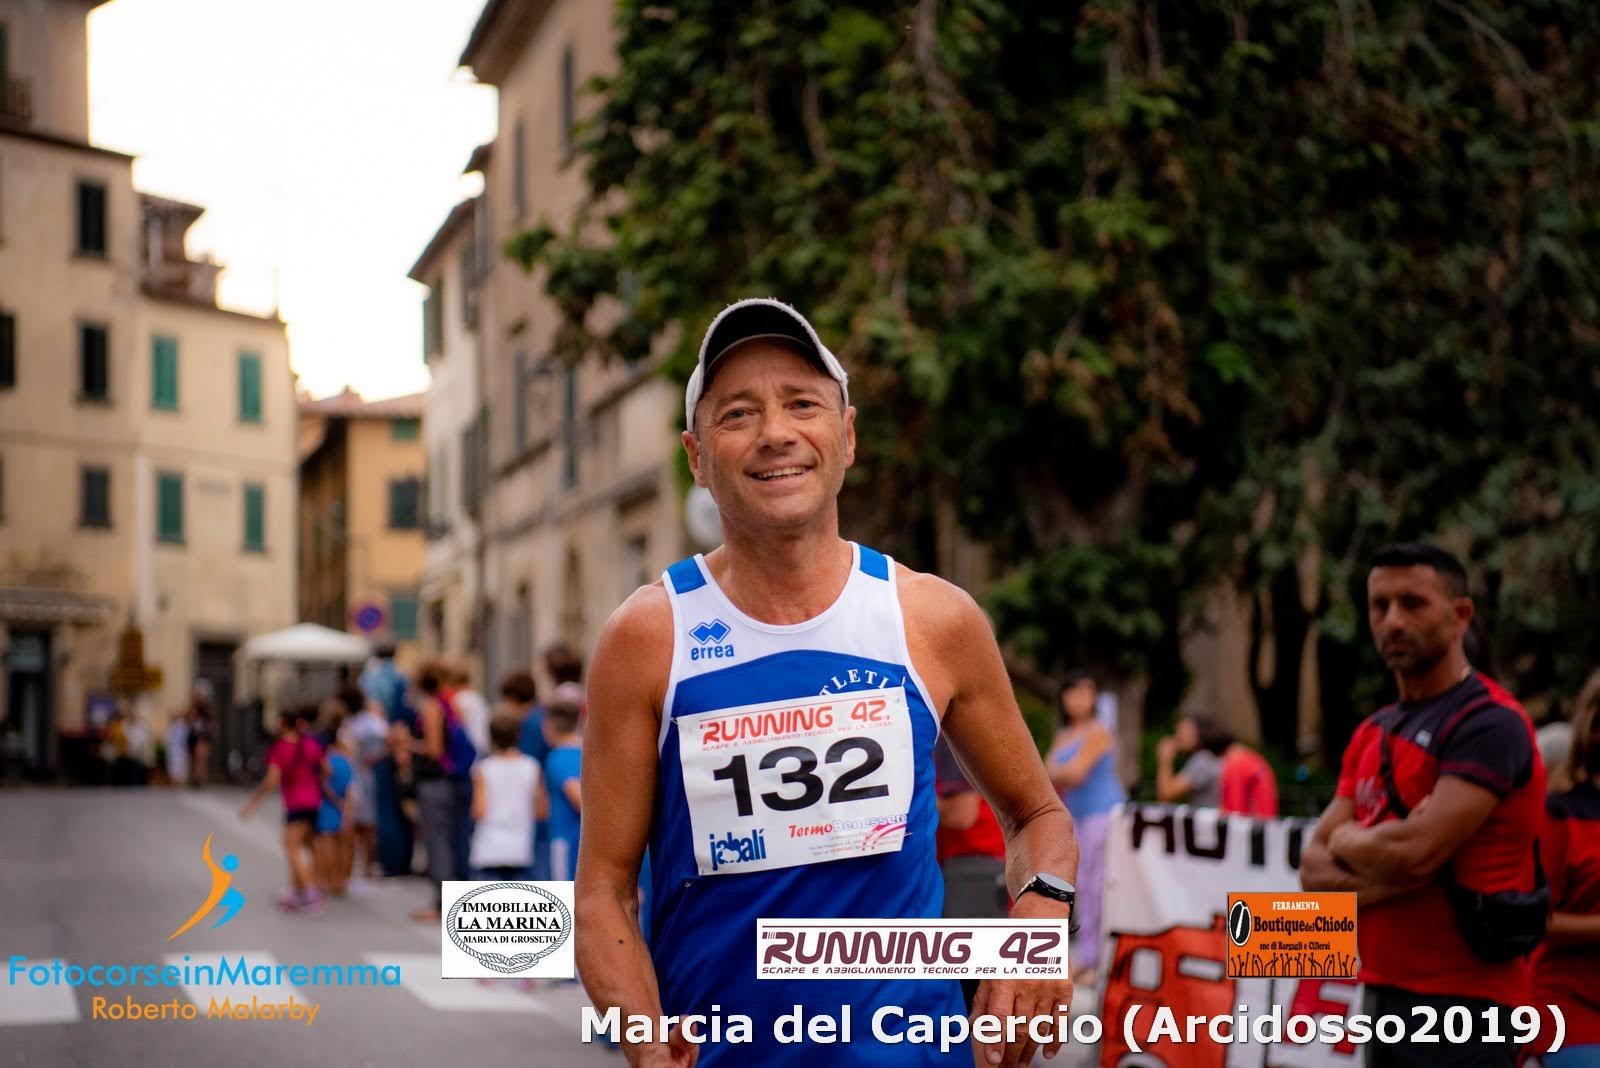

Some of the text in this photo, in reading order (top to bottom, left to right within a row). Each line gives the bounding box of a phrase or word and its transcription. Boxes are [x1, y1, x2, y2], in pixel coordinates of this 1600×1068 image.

[691, 644, 734, 660] errea
[702, 706, 833, 745] RUNNING
[713, 736, 889, 817] 132
